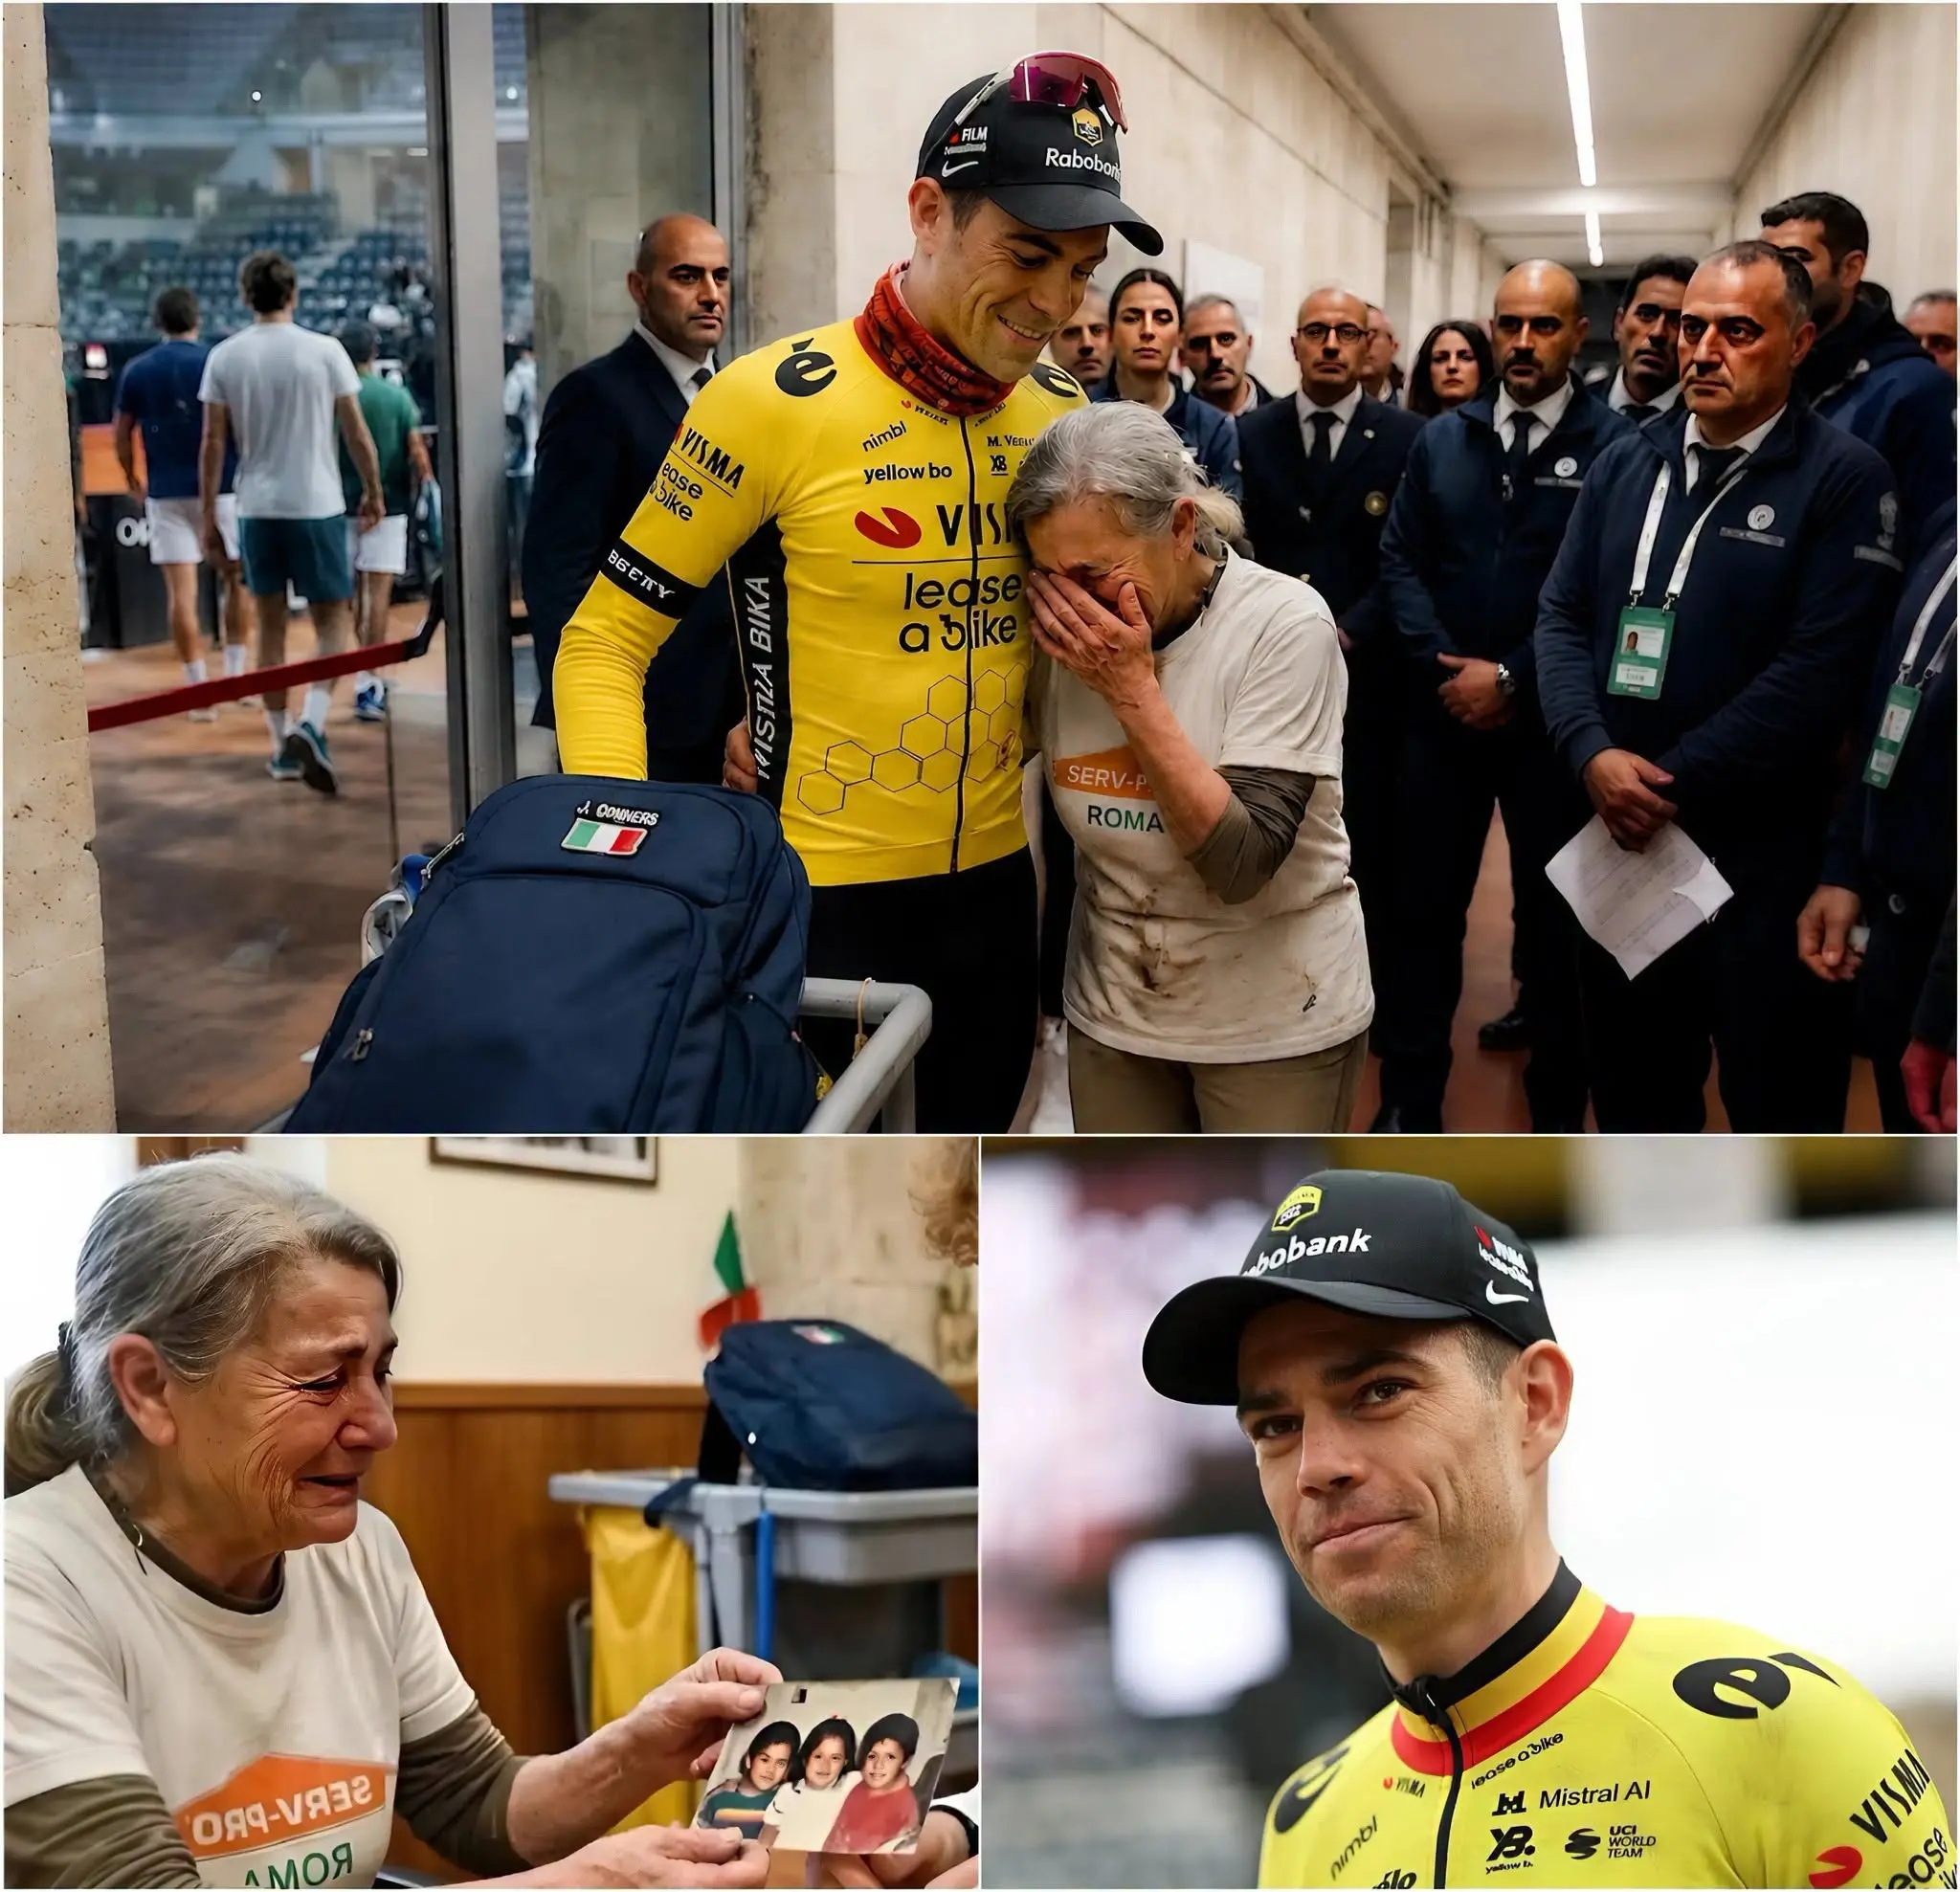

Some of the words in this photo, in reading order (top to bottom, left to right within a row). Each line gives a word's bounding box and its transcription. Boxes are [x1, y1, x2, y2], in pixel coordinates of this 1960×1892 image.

[861, 421, 907, 452] nimbl
[680, 428, 746, 490] VISMA
[863, 464, 924, 484] yellow
[928, 461, 953, 479] bo
[661, 462, 703, 501] ease
[936, 503, 1012, 546] VIS
[903, 571, 1023, 611] lease
[898, 622, 930, 653] a
[938, 609, 1018, 654] bike
[1067, 764, 1152, 792] SERV-P
[1087, 804, 1165, 834] ROMA
[1539, 1783, 1620, 1809] Mistral
[1623, 1780, 1651, 1802] AI
[1848, 1748, 1931, 1844] VISMA
[1330, 1814, 1378, 1881] nimbl
[1608, 1836, 1657, 1847] WORLD
[1609, 1824, 1637, 1836] UCI
[1607, 1847, 1644, 1859] TEAM
[1874, 1827, 1949, 1890] ease
